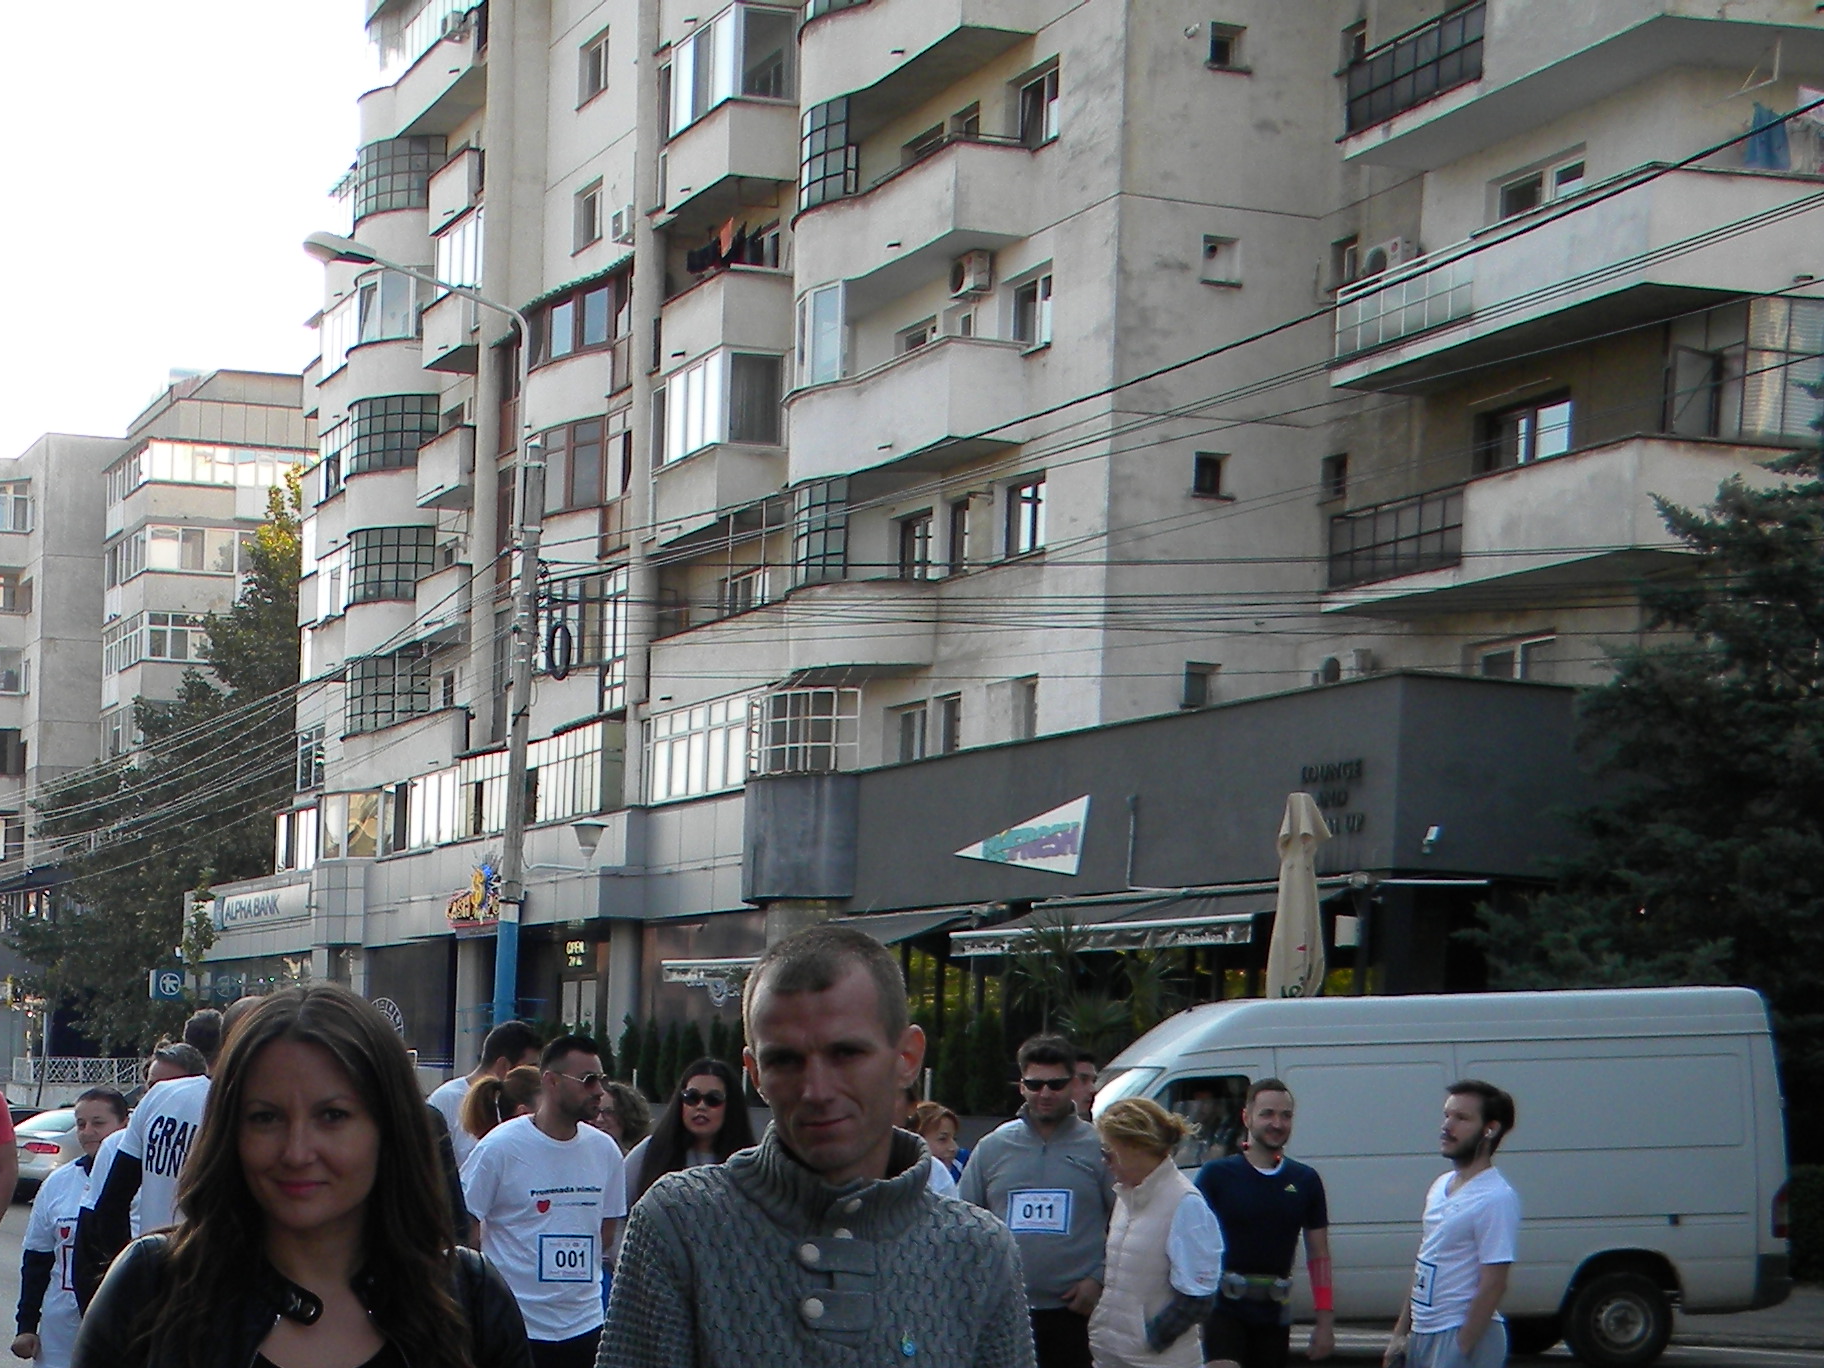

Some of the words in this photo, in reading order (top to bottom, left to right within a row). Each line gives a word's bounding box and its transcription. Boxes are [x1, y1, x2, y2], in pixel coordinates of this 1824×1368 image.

[225, 897, 253, 921] ALPHA
[253, 894, 280, 917] BANK
[148, 1115, 198, 1151] CRAI
[1023, 1204, 1053, 1219] 011
[556, 1250, 585, 1268] 001
